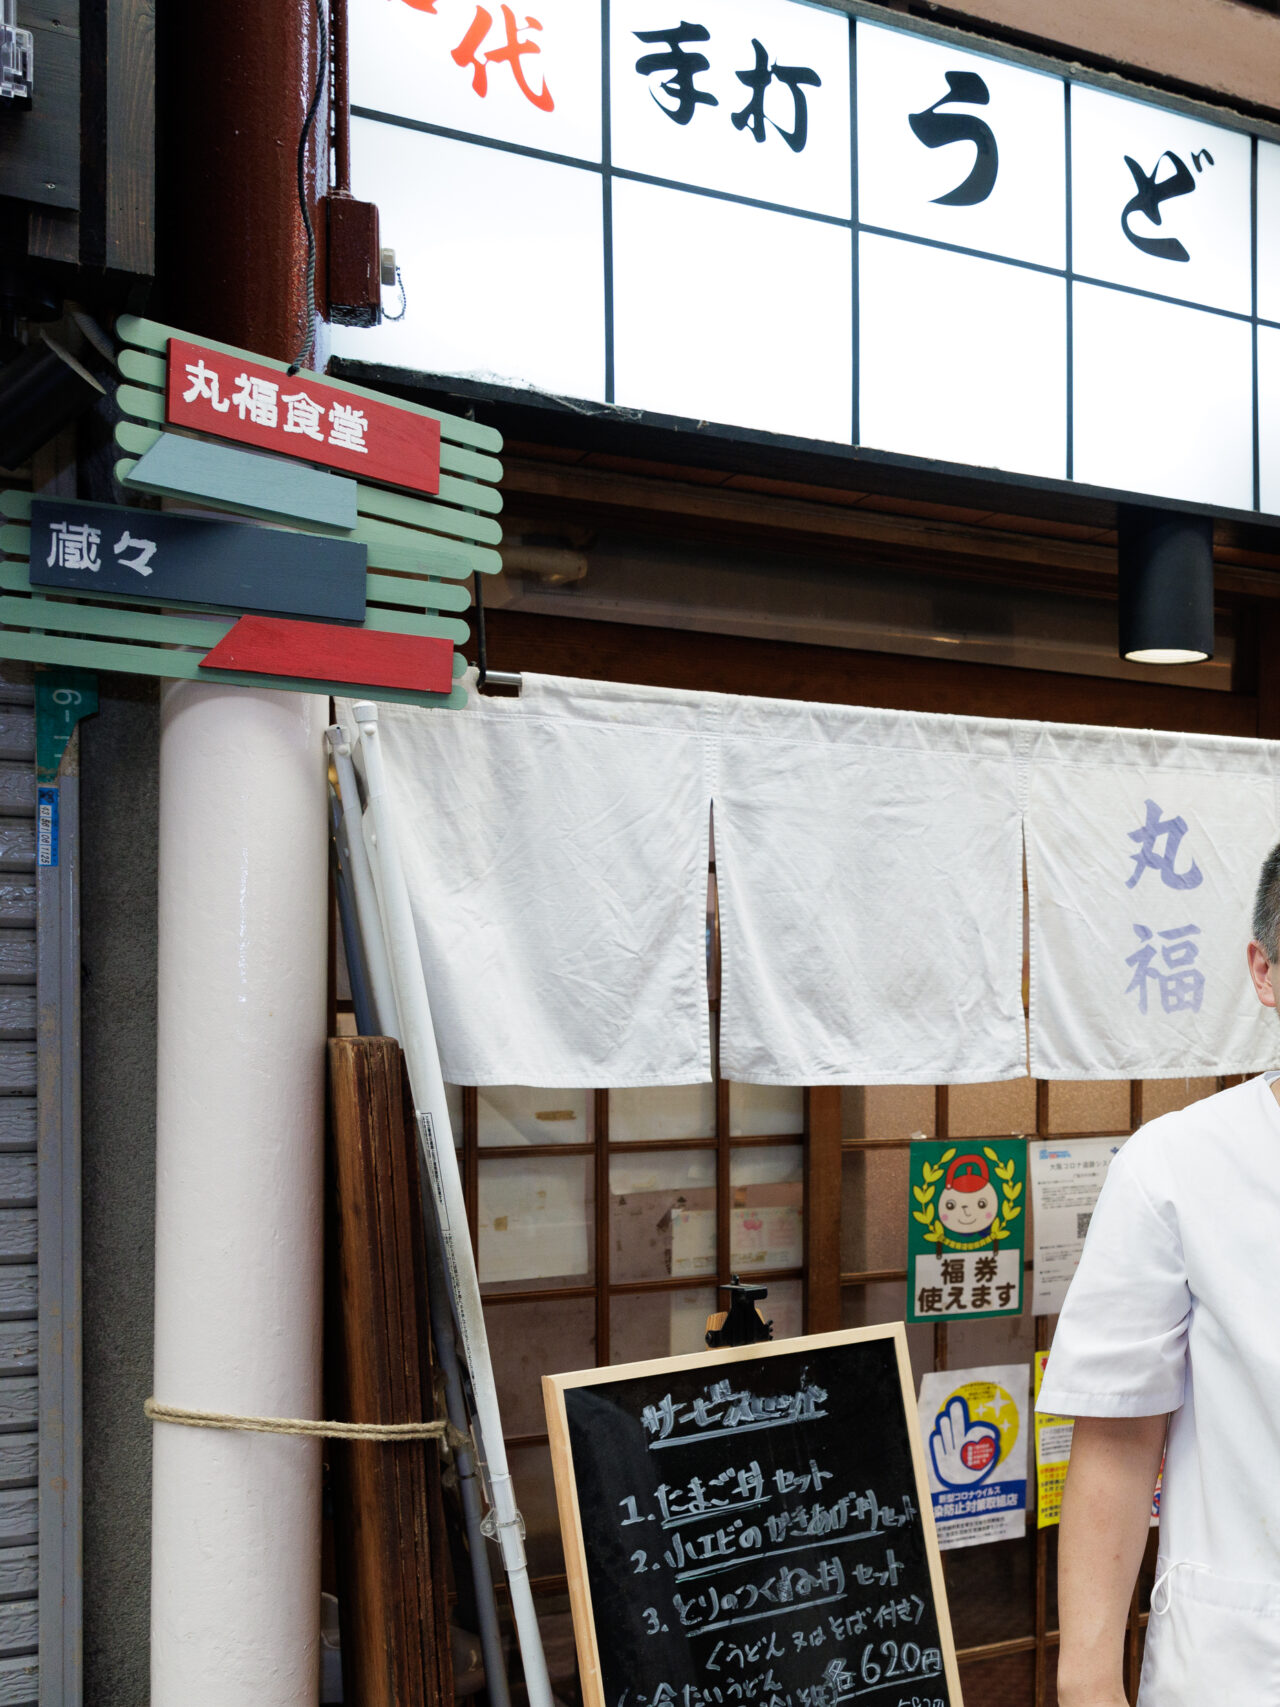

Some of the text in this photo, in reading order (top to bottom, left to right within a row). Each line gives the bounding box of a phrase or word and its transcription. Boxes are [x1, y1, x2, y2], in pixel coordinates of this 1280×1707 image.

[183, 359, 370, 455] 丸福食堂
[46, 520, 157, 577] 蔵々
[1125, 798, 1205, 1016] 丸福
[918, 1282, 1016, 1313] 使えます
[941, 1256, 998, 1285] 福券
